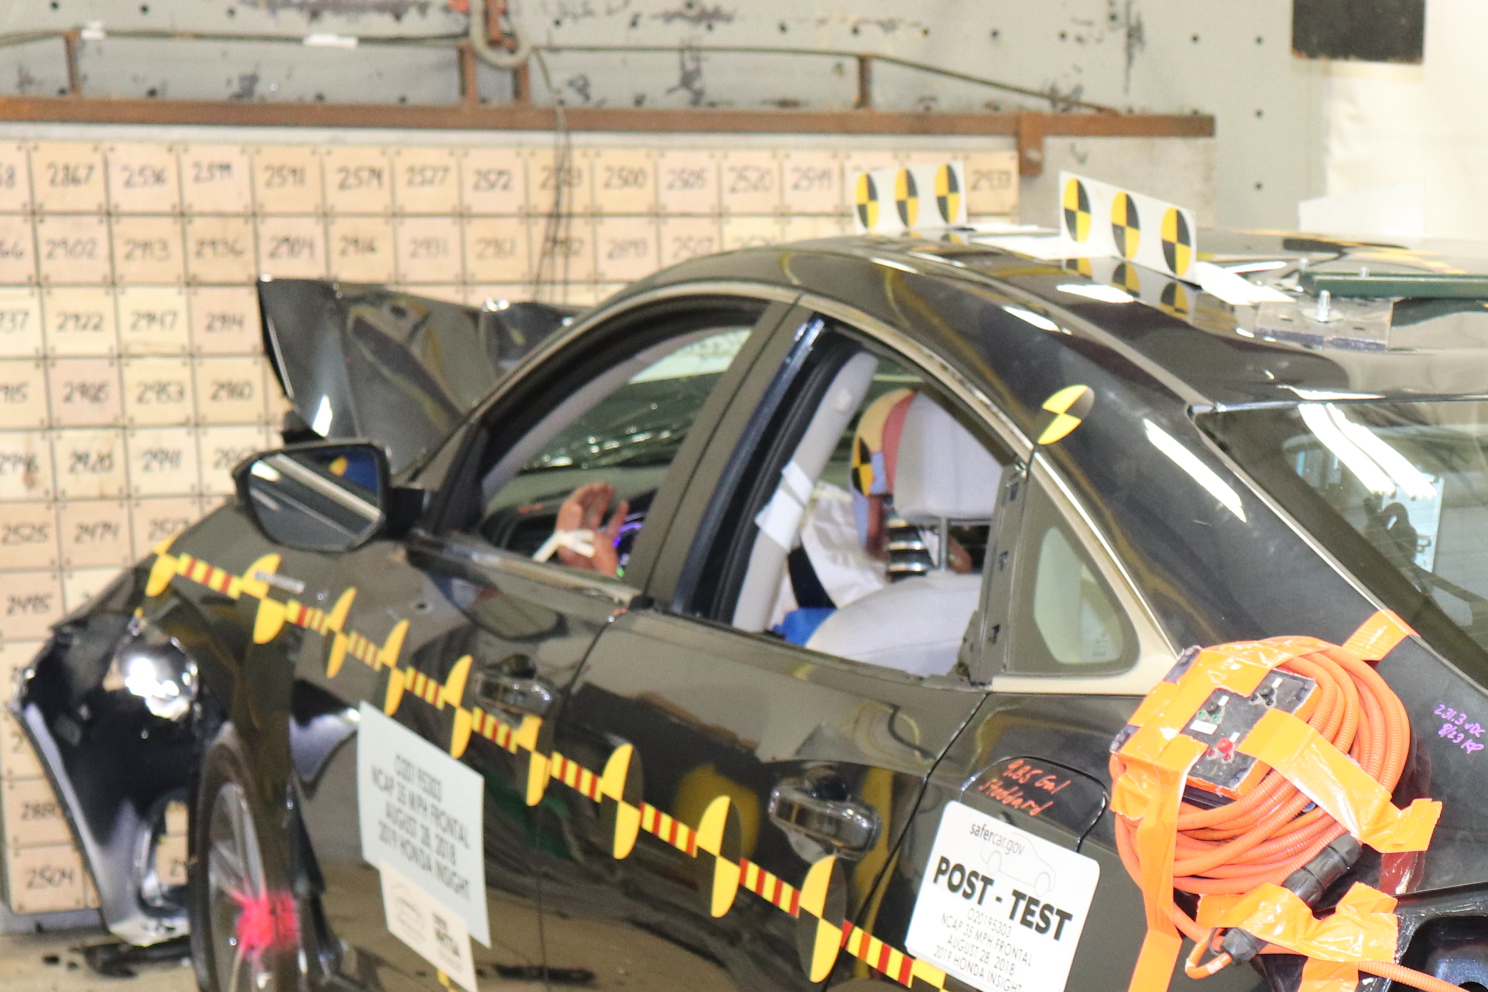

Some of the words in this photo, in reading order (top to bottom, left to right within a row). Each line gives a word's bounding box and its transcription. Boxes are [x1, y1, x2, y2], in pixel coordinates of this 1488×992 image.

[1034, 775, 1072, 795] Gal
[969, 822, 1026, 856] safercar.gov
[400, 837, 433, 873] HONDA
[435, 859, 471, 902] INSIGHT
[933, 856, 994, 905] POST
[1008, 888, 1073, 941] TEST
[941, 912, 961, 933] NCAP
[962, 922, 973, 937] 35
[975, 928, 993, 948] MPH
[995, 934, 1033, 968] FRONTAL
[947, 935, 979, 961] AUGUST
[993, 955, 1015, 976] 2018
[933, 945, 952, 963] 2019
[953, 953, 985, 979] HONDA
